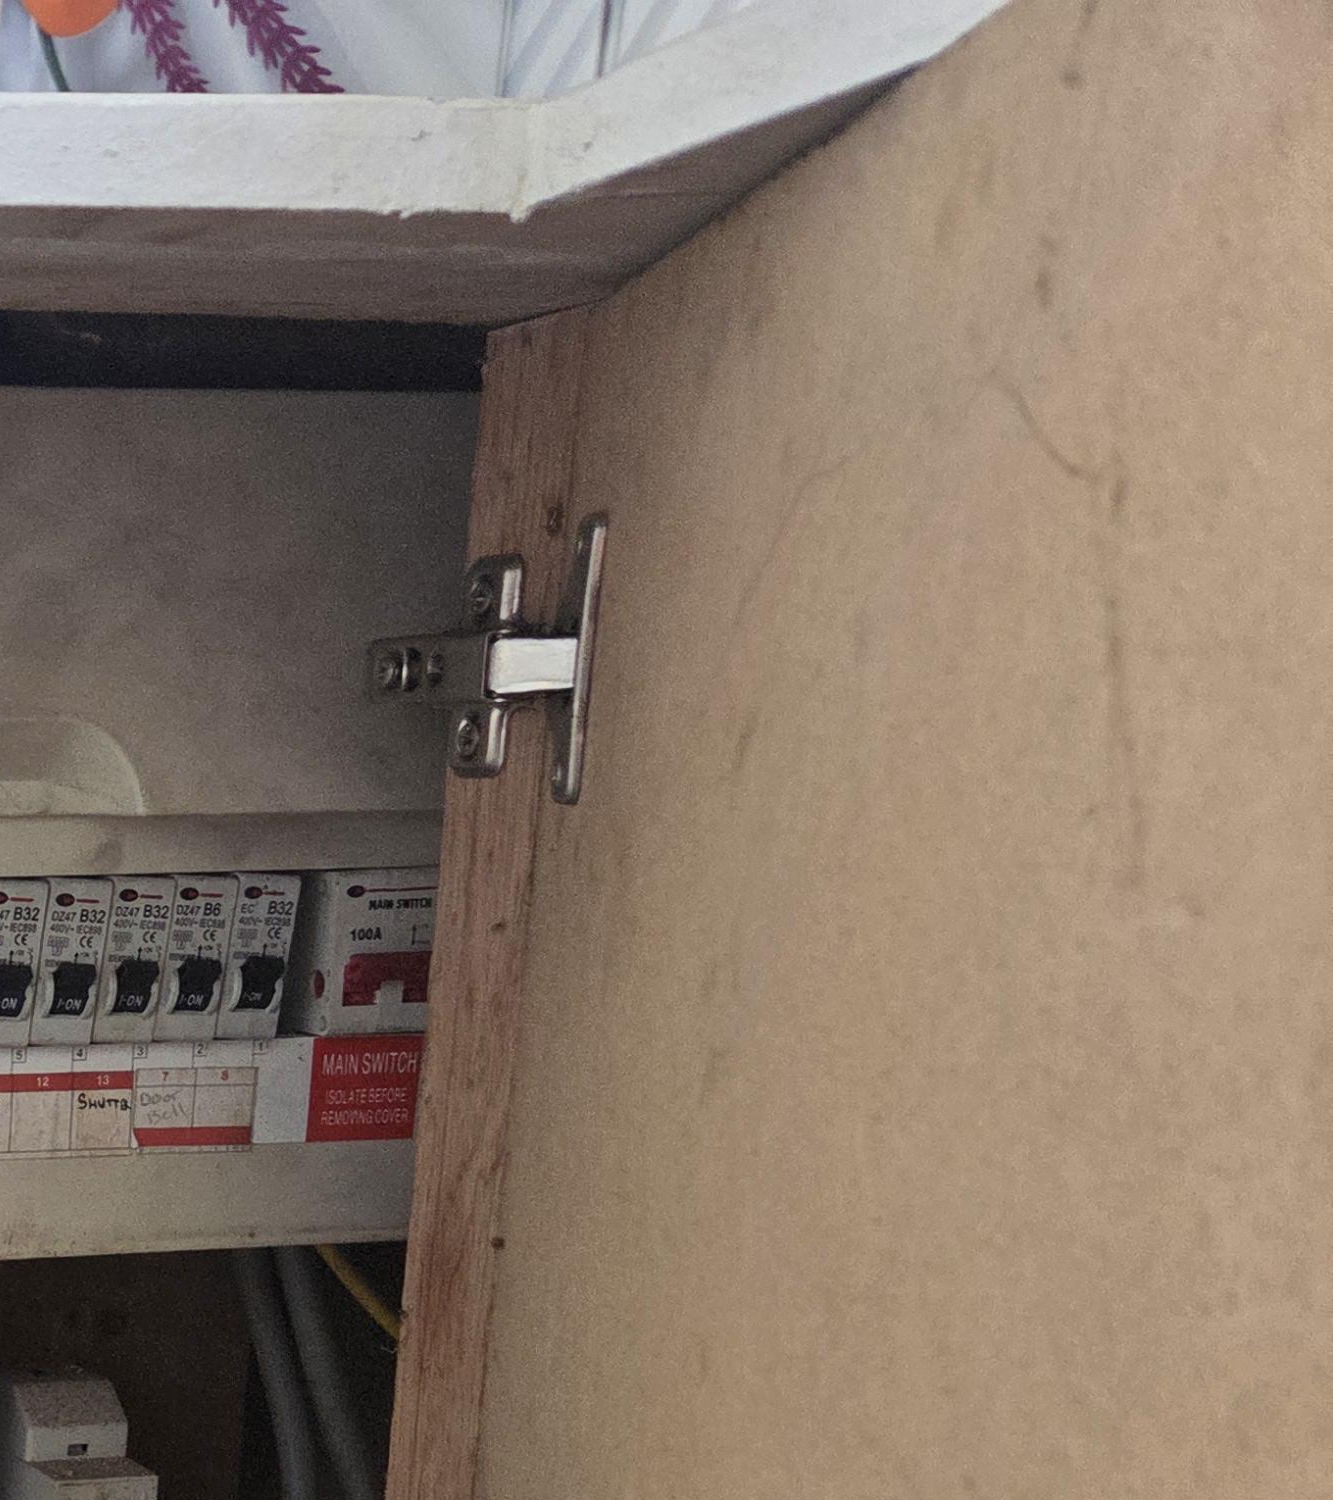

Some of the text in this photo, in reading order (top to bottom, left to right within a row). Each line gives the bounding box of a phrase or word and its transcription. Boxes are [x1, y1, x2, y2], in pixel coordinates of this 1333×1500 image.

[13, 908, 40, 921] B32
[143, 905, 169, 919] B32
[204, 903, 221, 916] B6
[267, 902, 293, 915] B32
[79, 909, 106, 924] B32
[350, 927, 382, 941] 100A
[322, 1052, 417, 1075] MAIN SWITCH
[325, 1087, 407, 1105] ISOLATE BEFORE
[321, 1107, 408, 1126] REMOVING COVER
